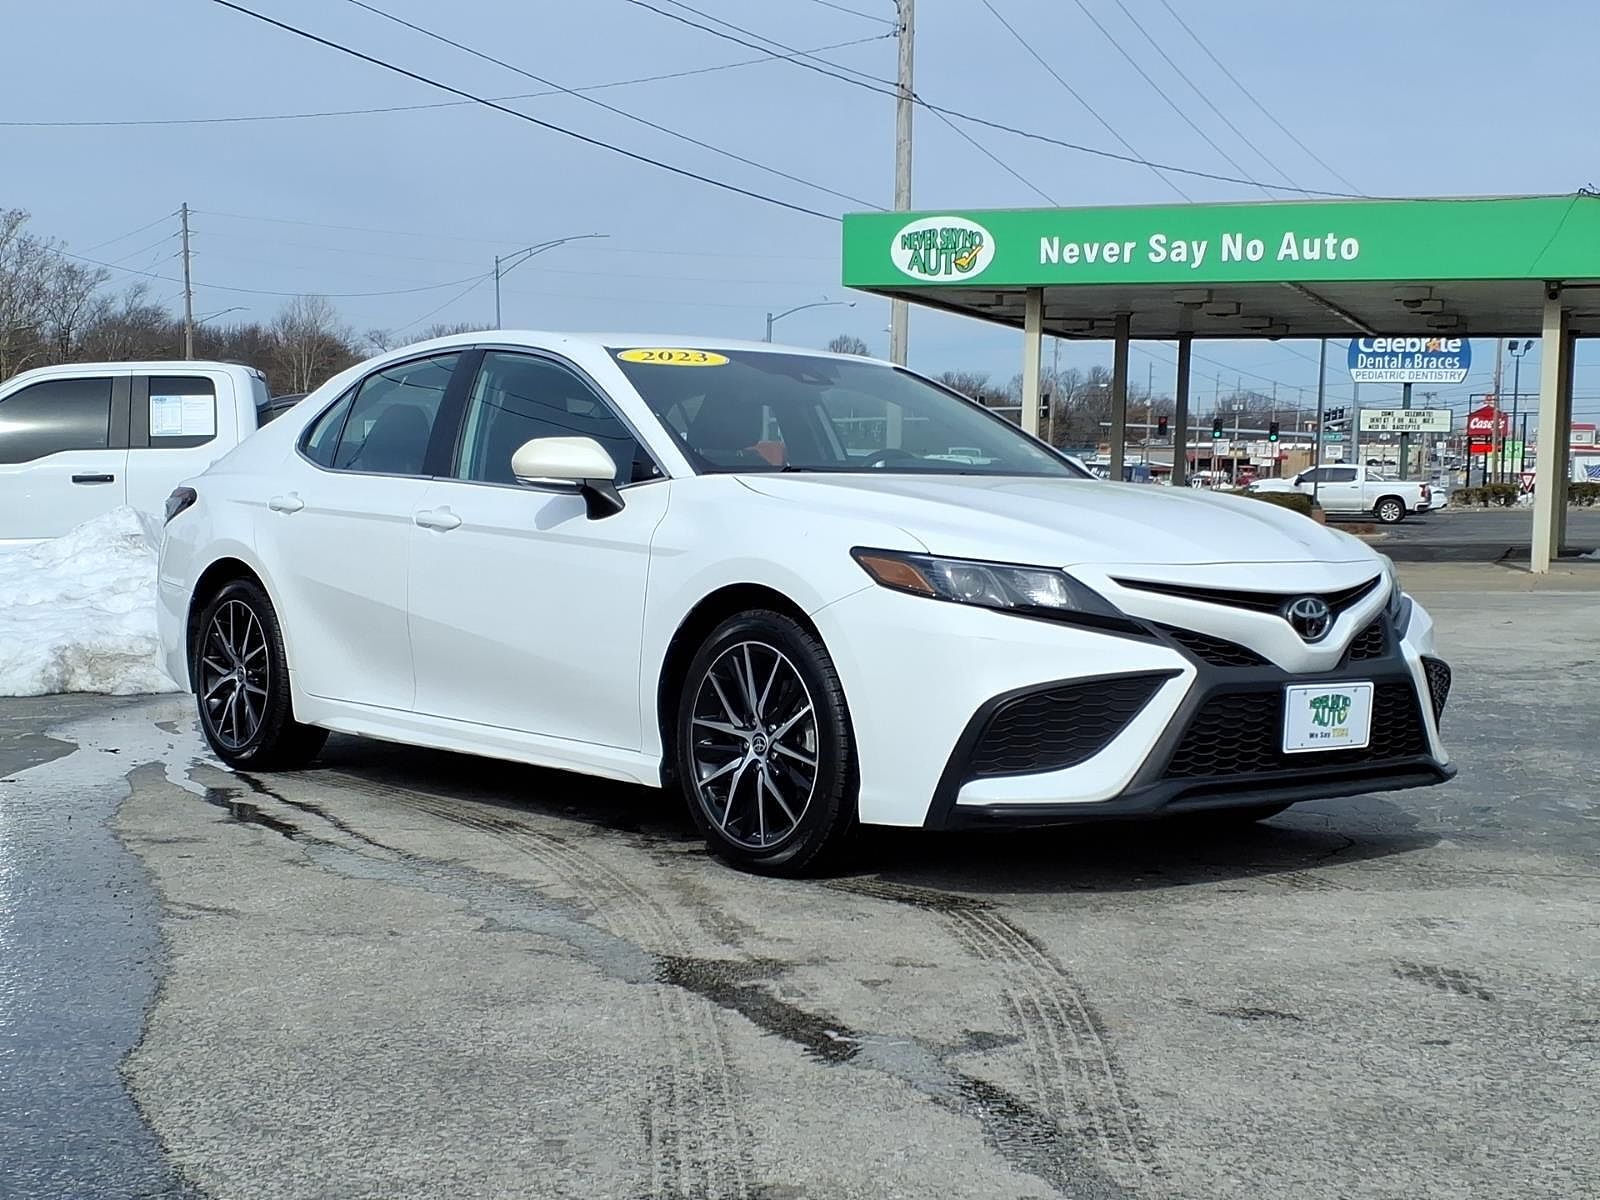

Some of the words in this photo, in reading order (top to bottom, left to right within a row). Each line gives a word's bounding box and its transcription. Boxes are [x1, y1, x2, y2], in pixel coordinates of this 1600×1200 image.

[901, 228, 939, 250] NEVER
[940, 227, 962, 250] SAY
[962, 228, 984, 249] NO
[1040, 236, 1136, 264] Never
[1148, 233, 1208, 269] Say
[1221, 233, 1265, 262] No
[1277, 232, 1360, 261] Auto
[907, 247, 978, 276] AUTO
[641, 351, 708, 362] 2023
[1357, 353, 1402, 369] Dental
[1404, 358, 1413, 369] &
[1414, 353, 1460, 369] Braces
[1355, 370, 1407, 380] PEDIATRIC
[1408, 370, 1463, 380] DENTISTRY
[1312, 708, 1347, 727] AUTO
